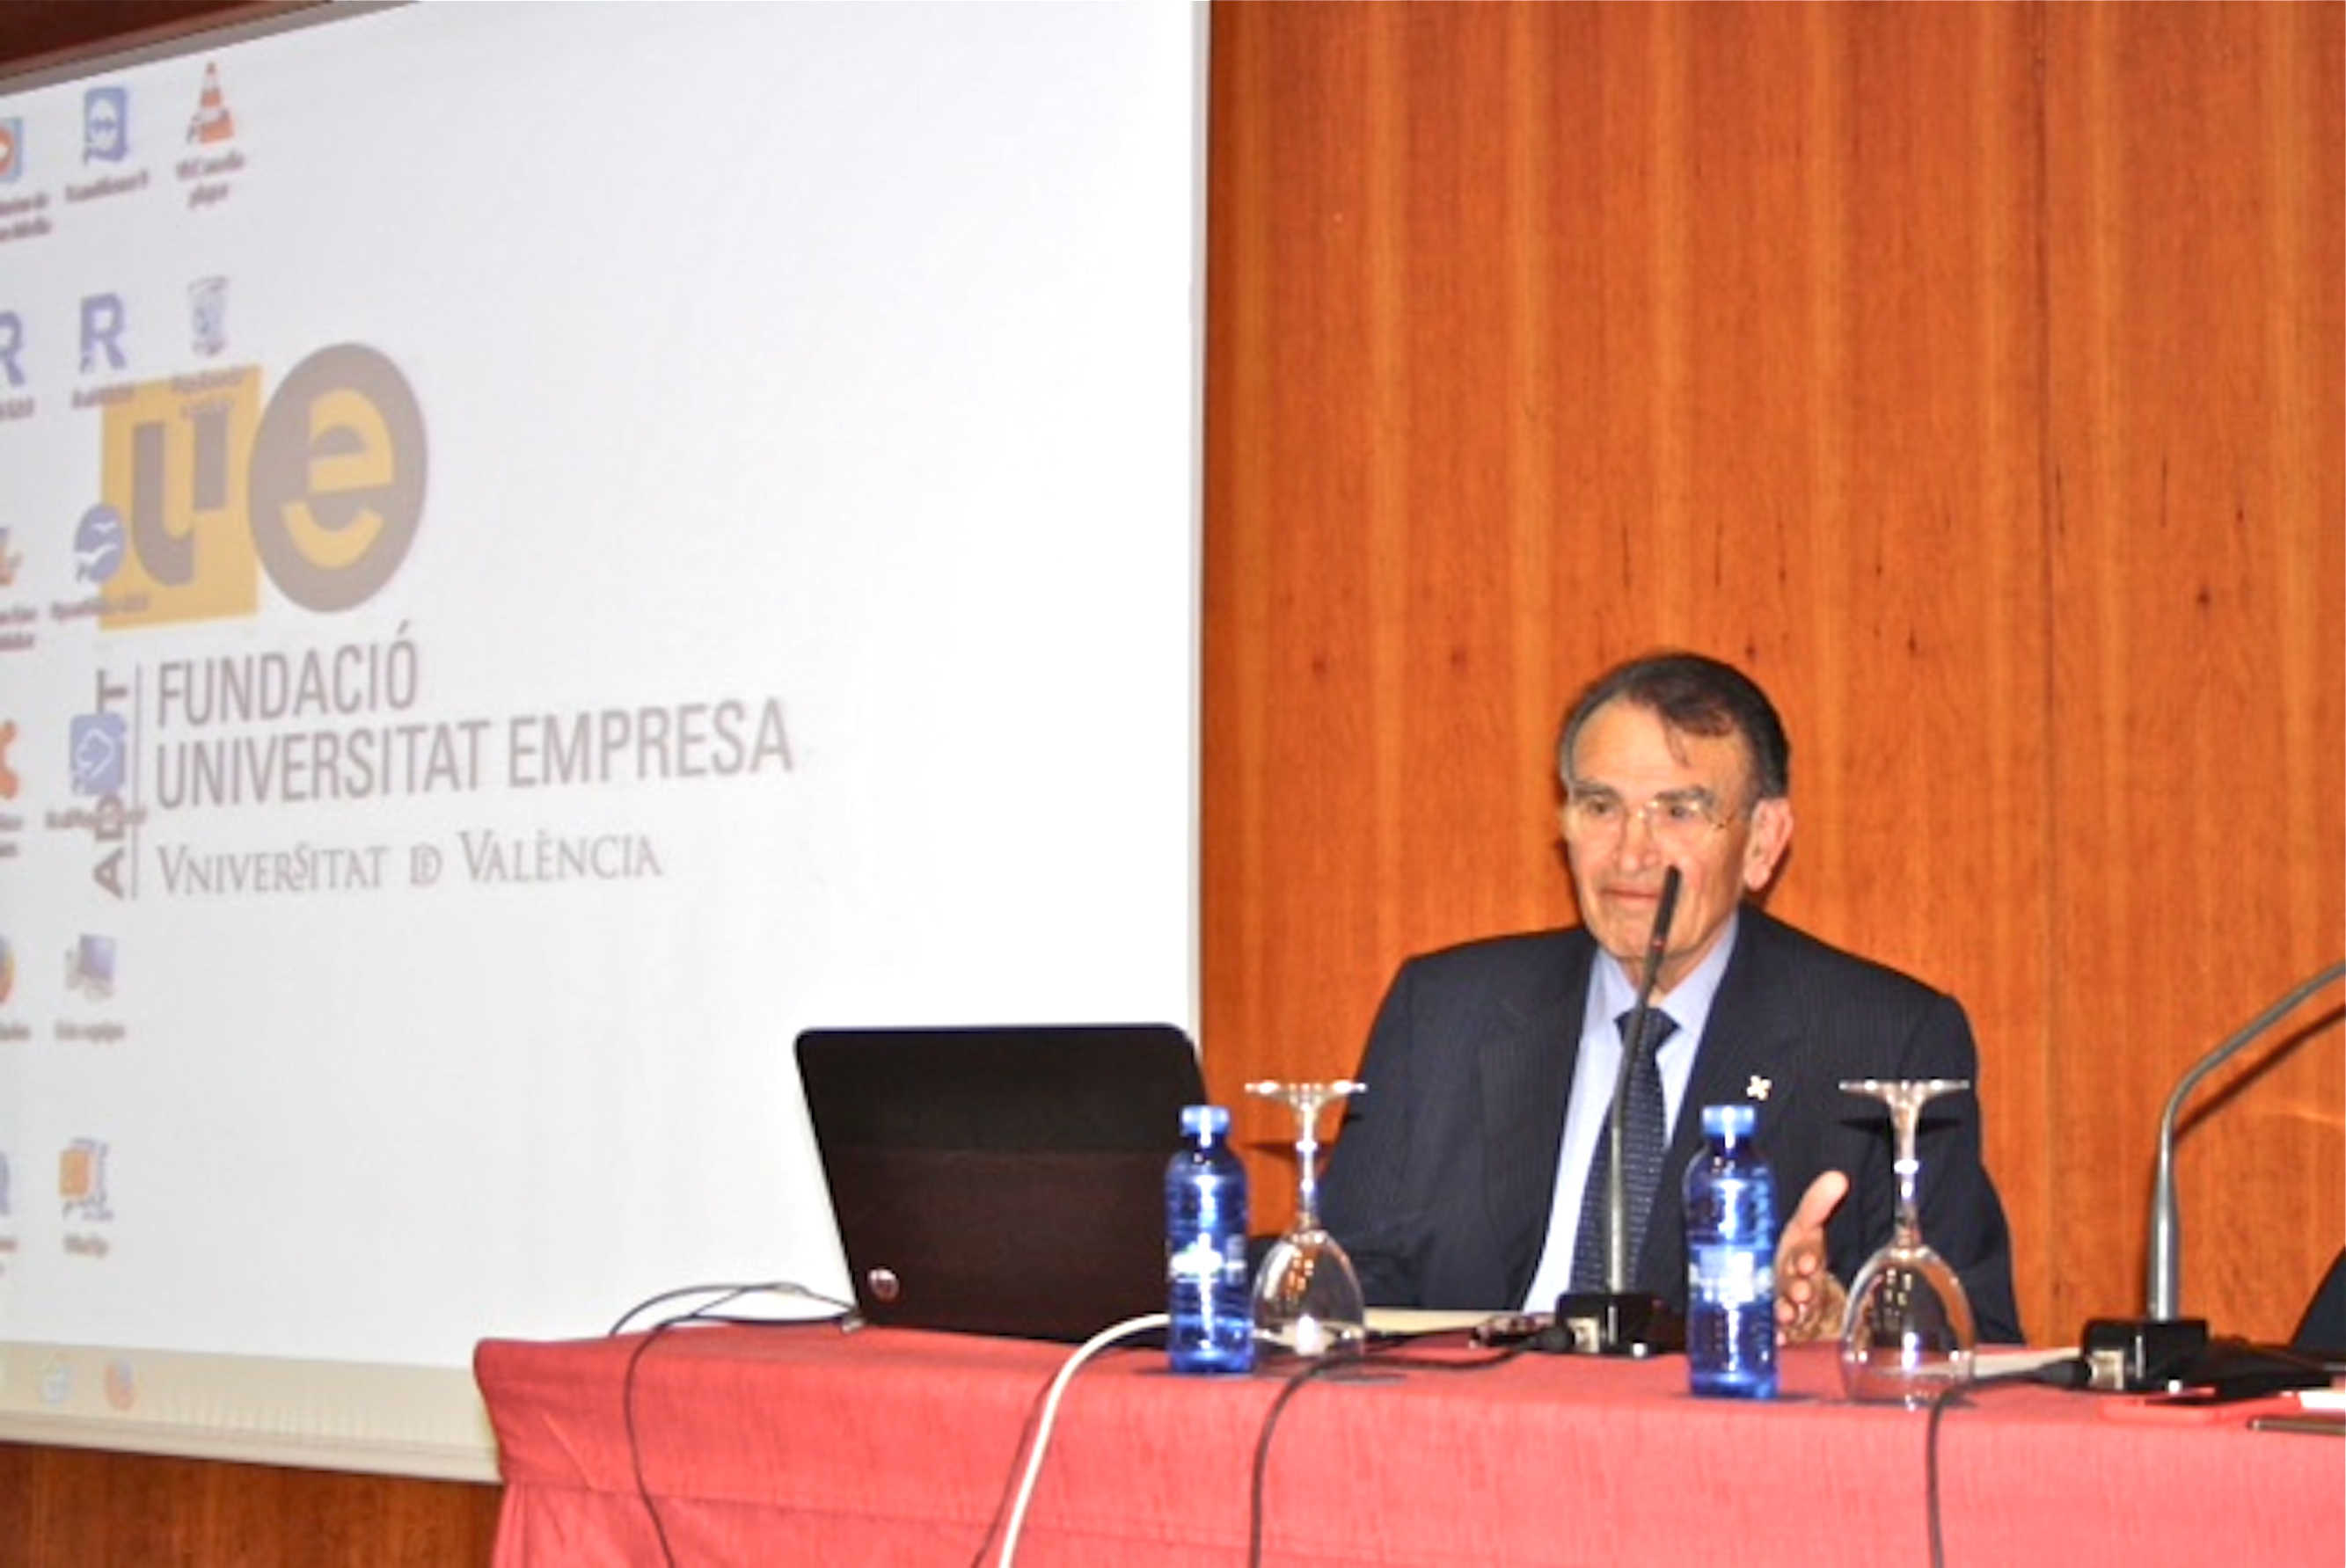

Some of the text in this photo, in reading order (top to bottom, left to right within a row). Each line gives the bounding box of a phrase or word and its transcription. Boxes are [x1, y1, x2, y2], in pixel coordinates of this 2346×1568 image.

[157, 619, 419, 729] FUNDACIÓ
[156, 696, 795, 810] UNIVERSITAT EMPRESA
